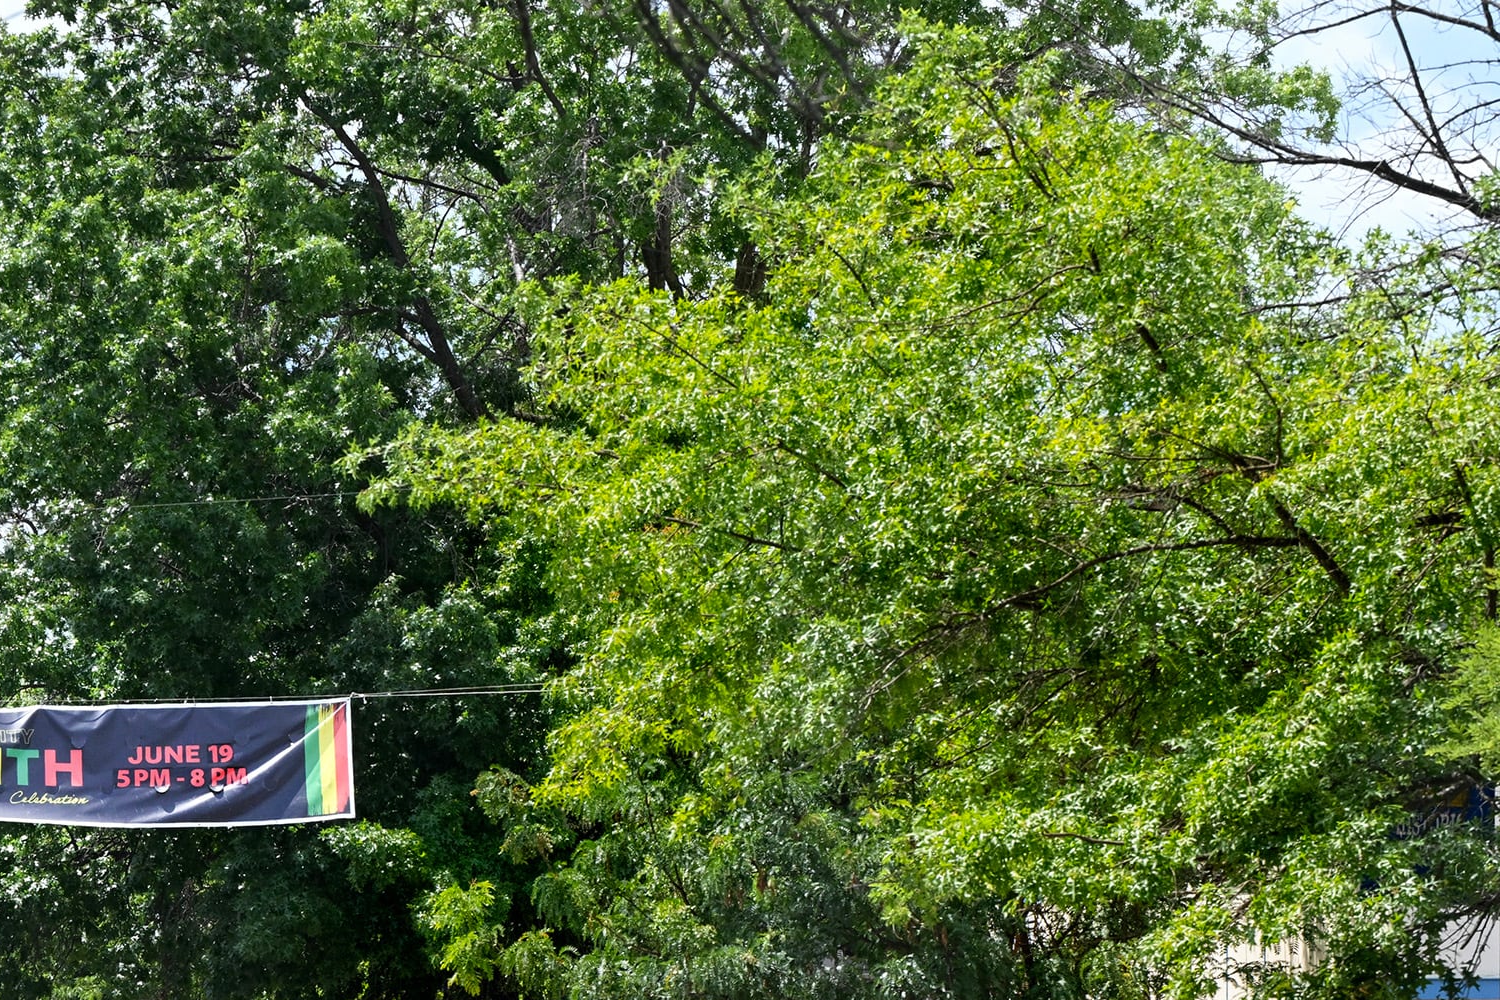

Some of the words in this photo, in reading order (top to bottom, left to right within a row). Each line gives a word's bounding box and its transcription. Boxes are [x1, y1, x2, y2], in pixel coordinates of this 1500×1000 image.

[127, 744, 201, 765] JUNE
[208, 744, 234, 764] 19
[9, 790, 90, 805] Celebration
